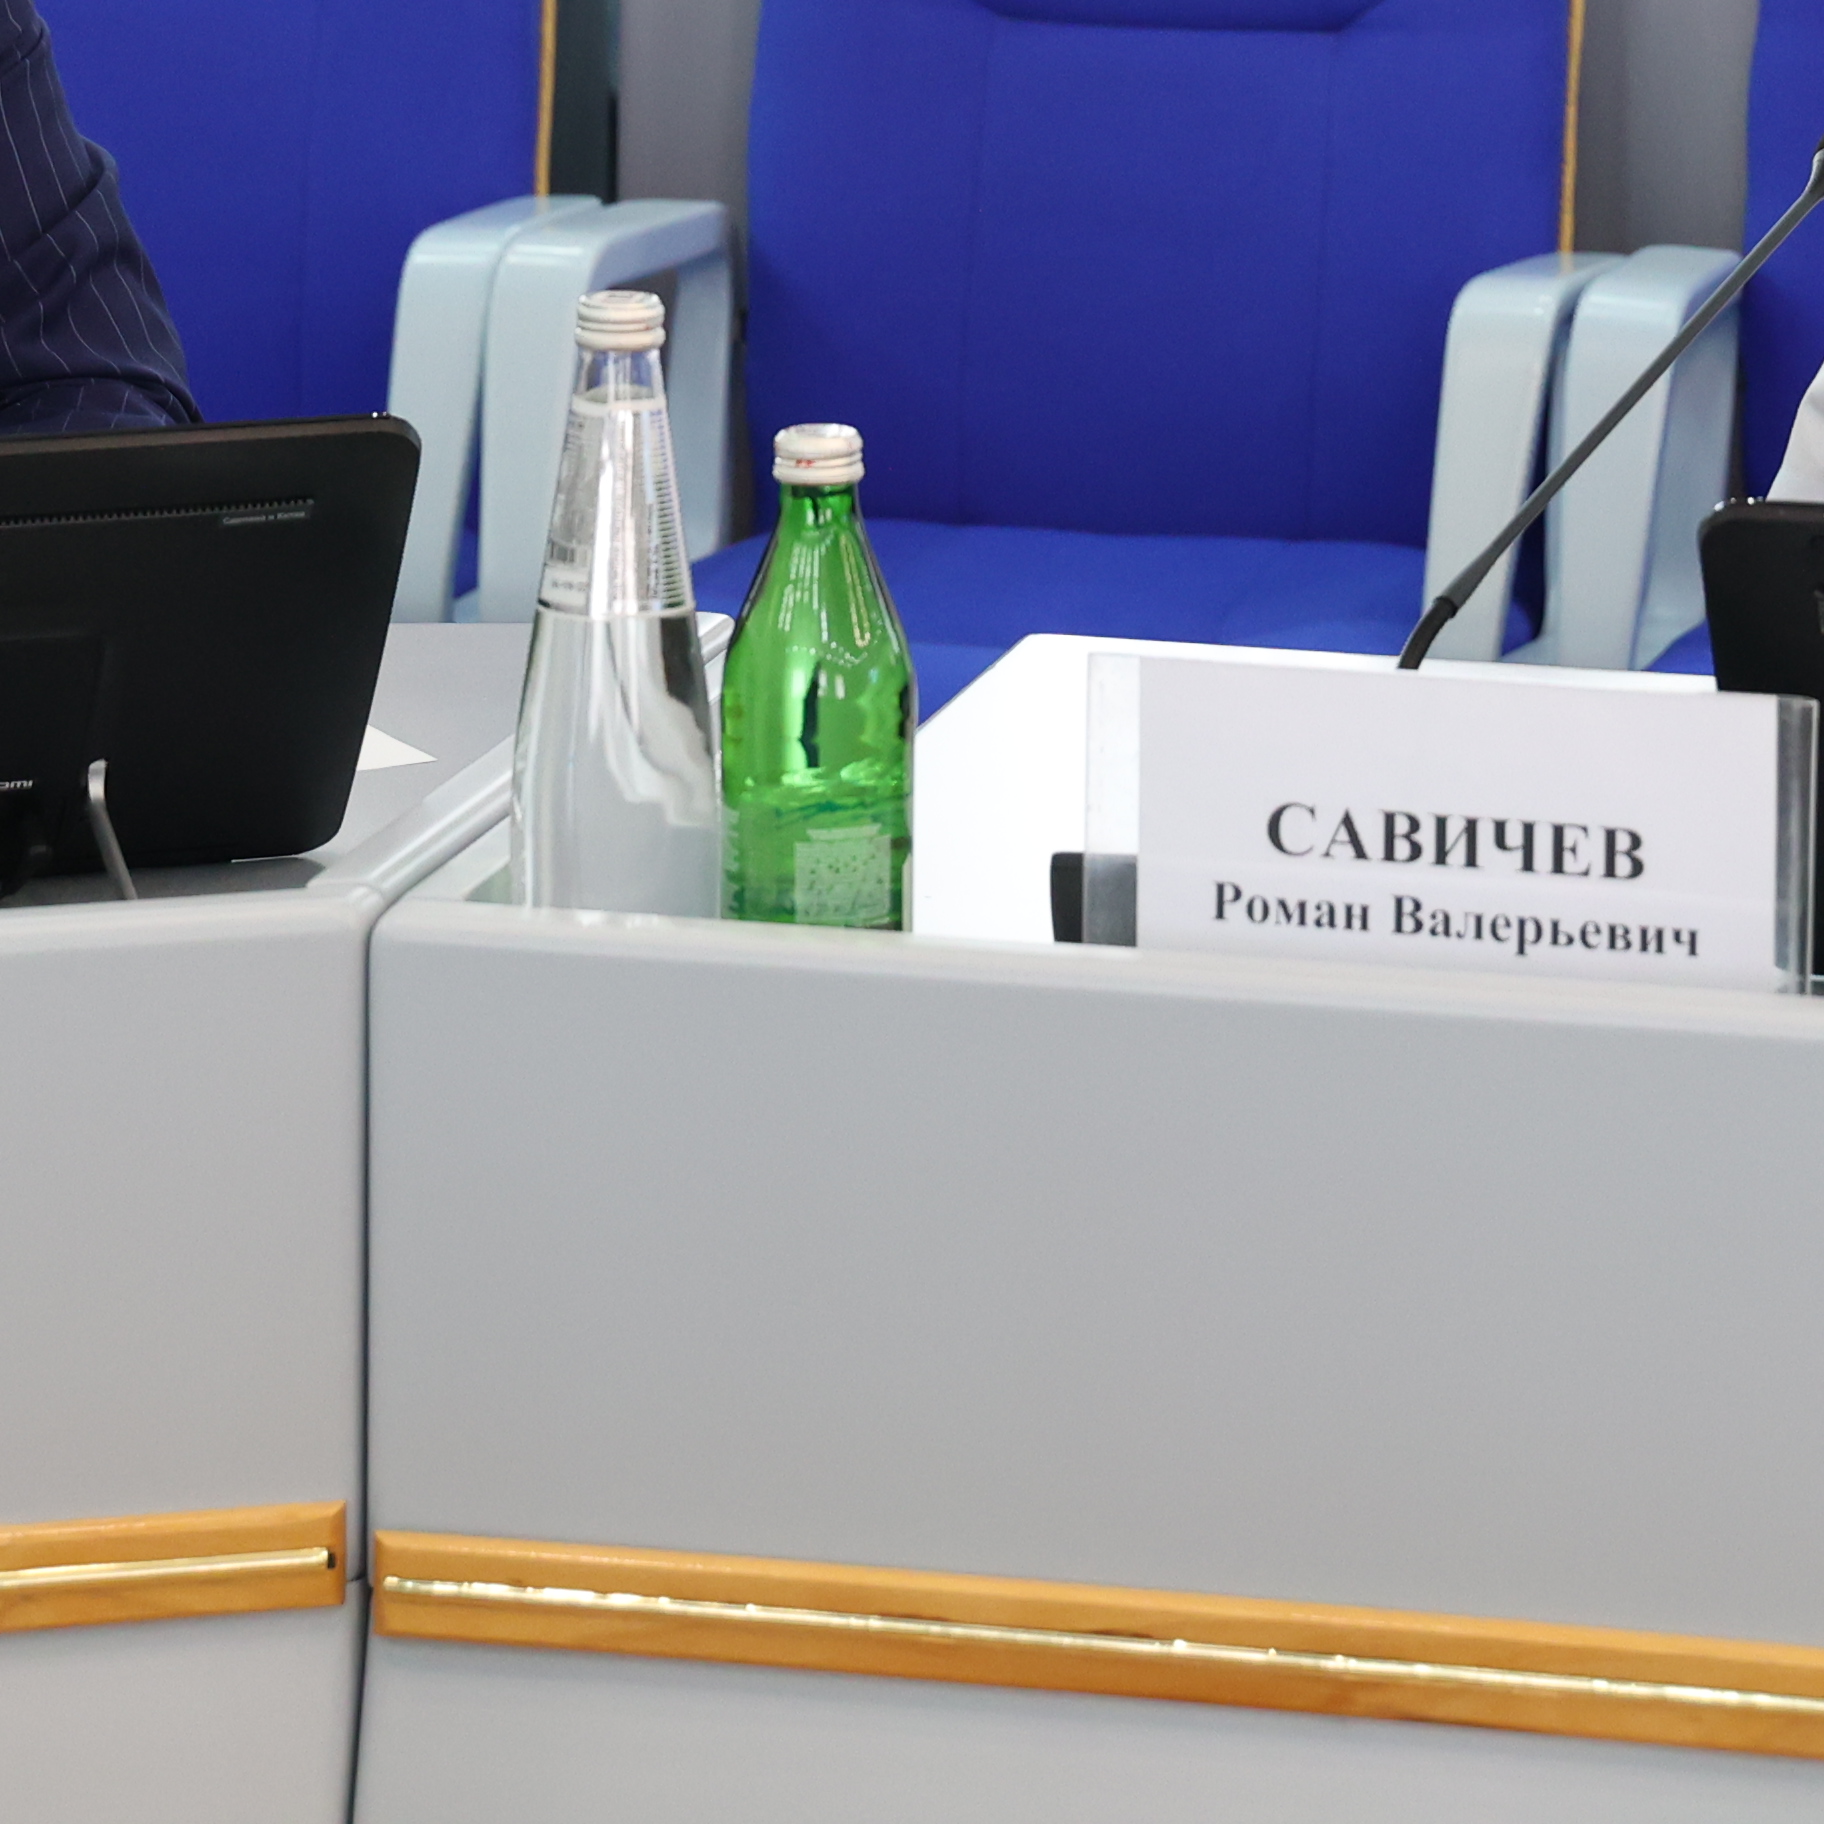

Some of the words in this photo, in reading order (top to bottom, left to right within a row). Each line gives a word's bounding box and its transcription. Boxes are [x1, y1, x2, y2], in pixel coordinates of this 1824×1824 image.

[1267, 803, 1645, 880] САВИЧЕВ
[1214, 882, 1369, 932] Роман
[1393, 896, 1698, 957] Валерьевич
